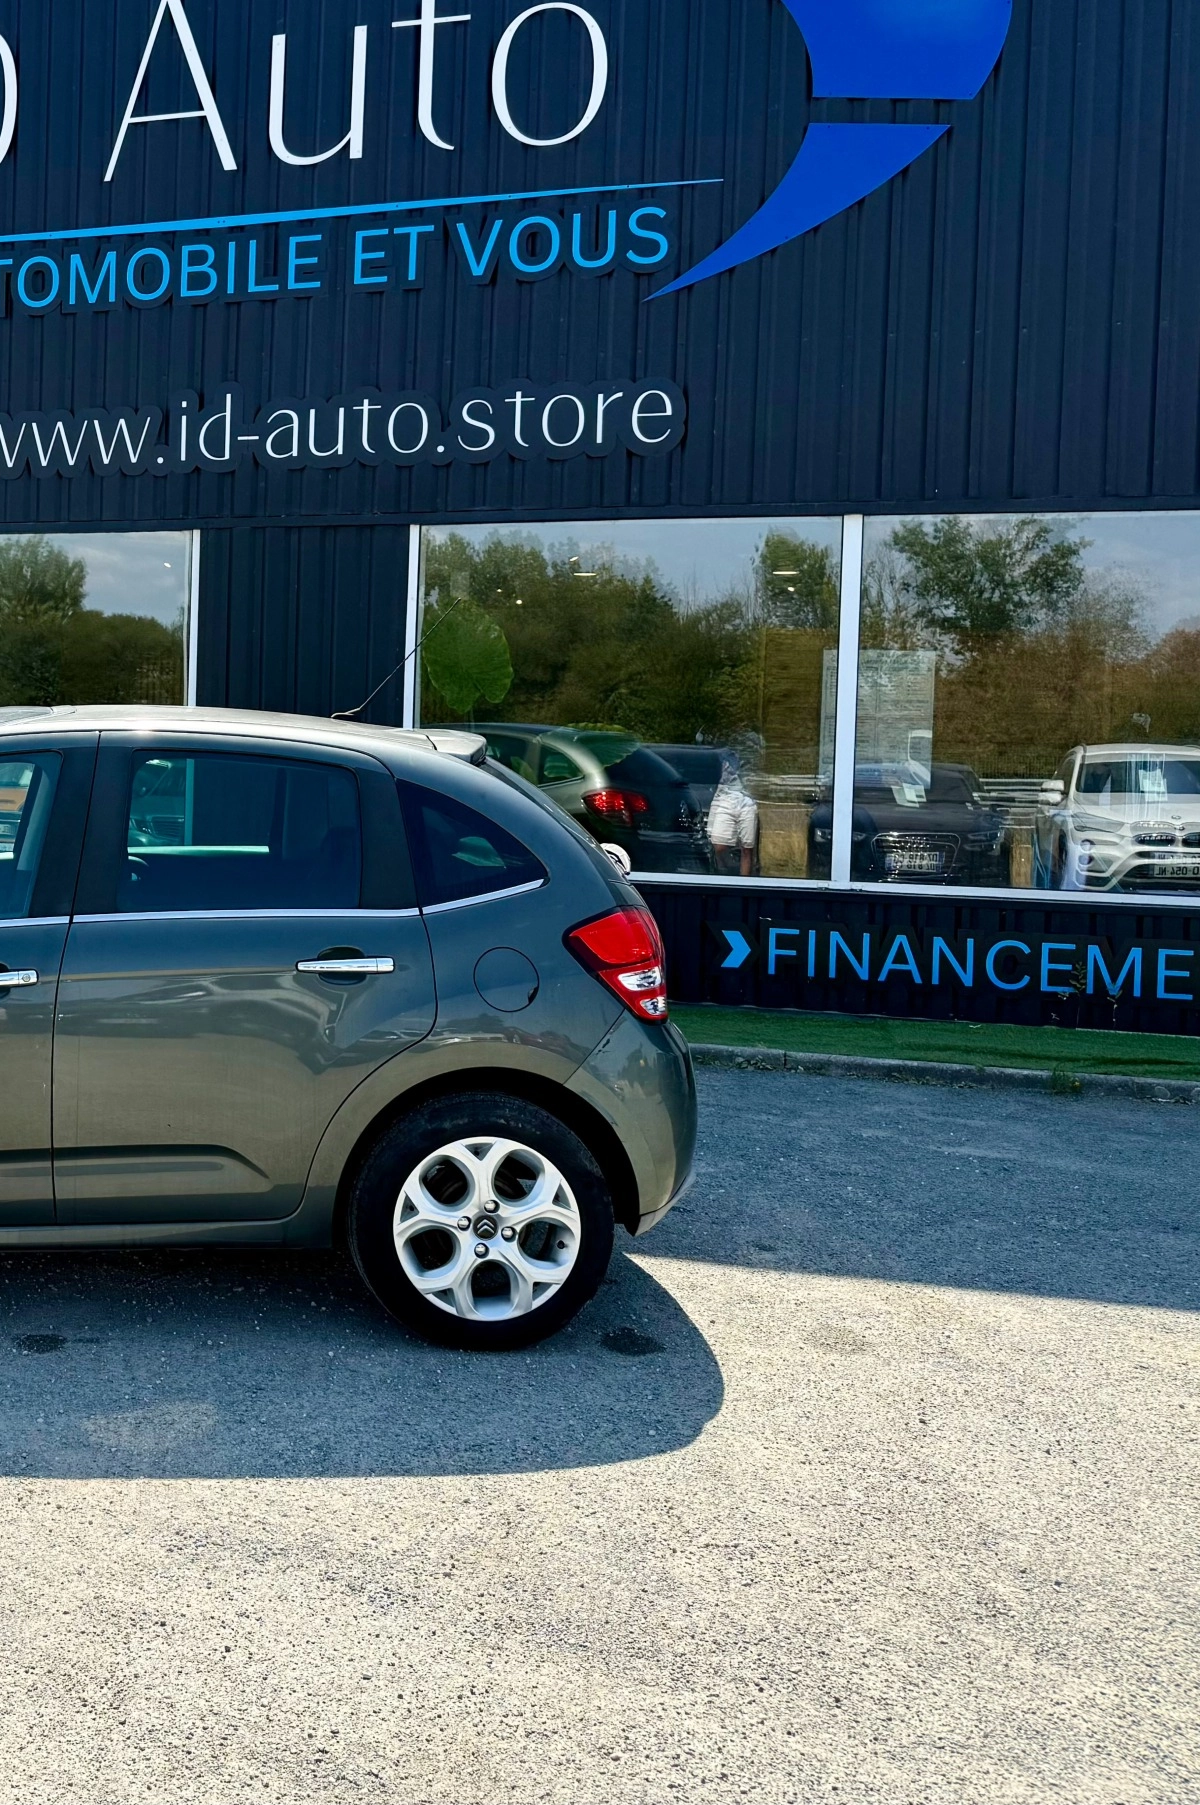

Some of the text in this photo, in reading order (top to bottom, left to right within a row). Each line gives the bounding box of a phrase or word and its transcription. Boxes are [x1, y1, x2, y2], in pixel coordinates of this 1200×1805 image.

[103, 0, 608, 182] Auto
[352, 223, 435, 286] ET
[456, 205, 670, 278] VOUS
[767, 926, 1195, 1001] FINANCEME
